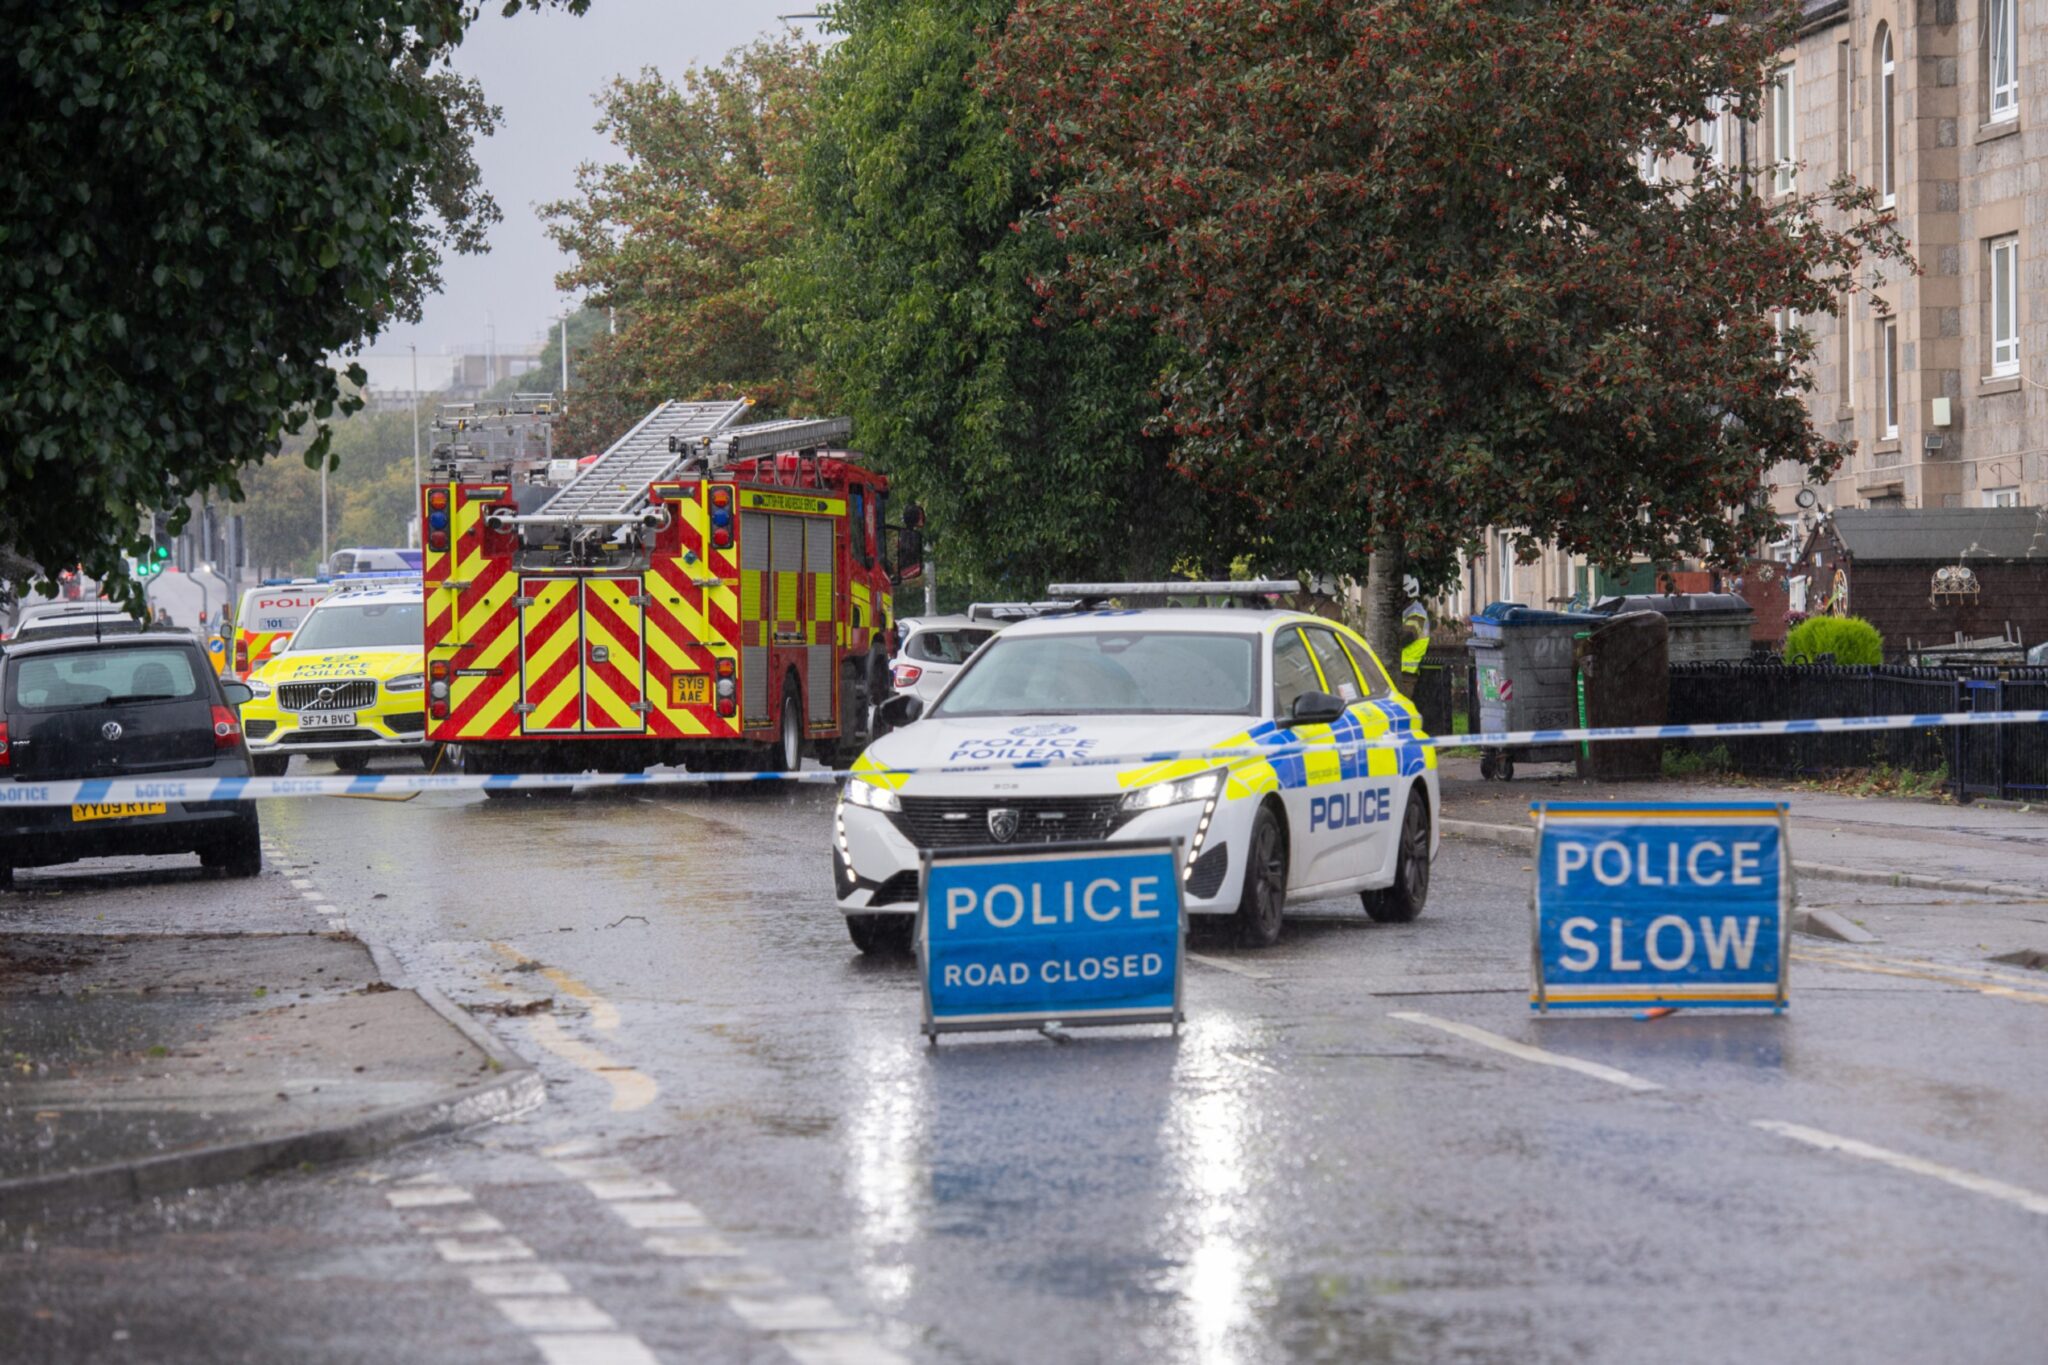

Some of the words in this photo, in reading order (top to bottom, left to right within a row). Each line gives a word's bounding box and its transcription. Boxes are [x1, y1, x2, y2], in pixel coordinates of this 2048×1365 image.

[259, 598, 325, 609] POLI
[266, 619, 283, 628] 101
[297, 662, 371, 671] POLICE
[293, 669, 368, 678] POILEAS
[678, 678, 705, 689] SY19
[680, 690, 702, 702] AAE
[302, 715, 328, 726] SF74
[331, 714, 351, 724] BVC
[958, 738, 1100, 748] POLICE
[949, 749, 1089, 760] POILEAS
[1310, 787, 1390, 832] POLICE
[1557, 841, 1762, 886] POLICE
[946, 876, 1161, 931] POLICE
[1558, 915, 1761, 972] SLOW
[943, 963, 1030, 987] ROAD
[1040, 953, 1163, 982] CLOSED
